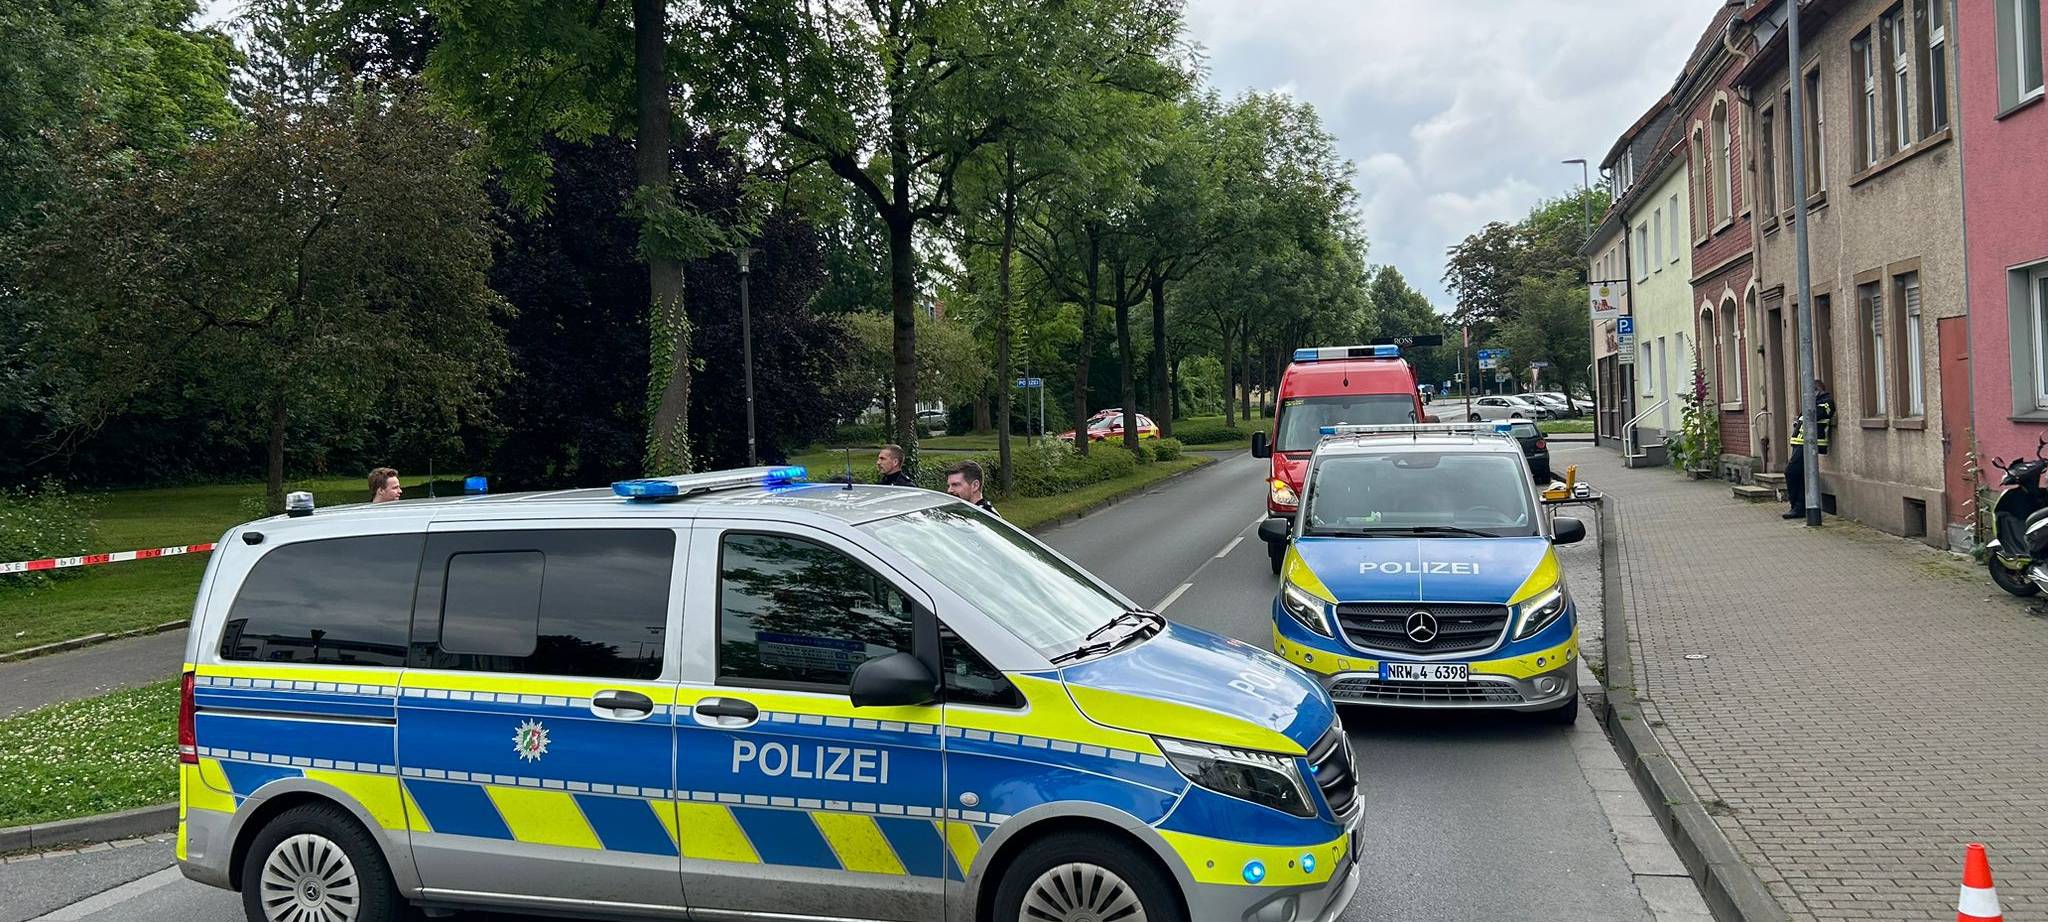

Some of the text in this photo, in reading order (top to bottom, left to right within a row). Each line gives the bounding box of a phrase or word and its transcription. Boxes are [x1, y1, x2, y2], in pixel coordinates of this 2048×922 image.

[1620, 319, 1629, 333] P
[1360, 562, 1480, 575] POLIZEI
[1388, 665, 1413, 679] NRW
[732, 740, 889, 784] POLIZEI
